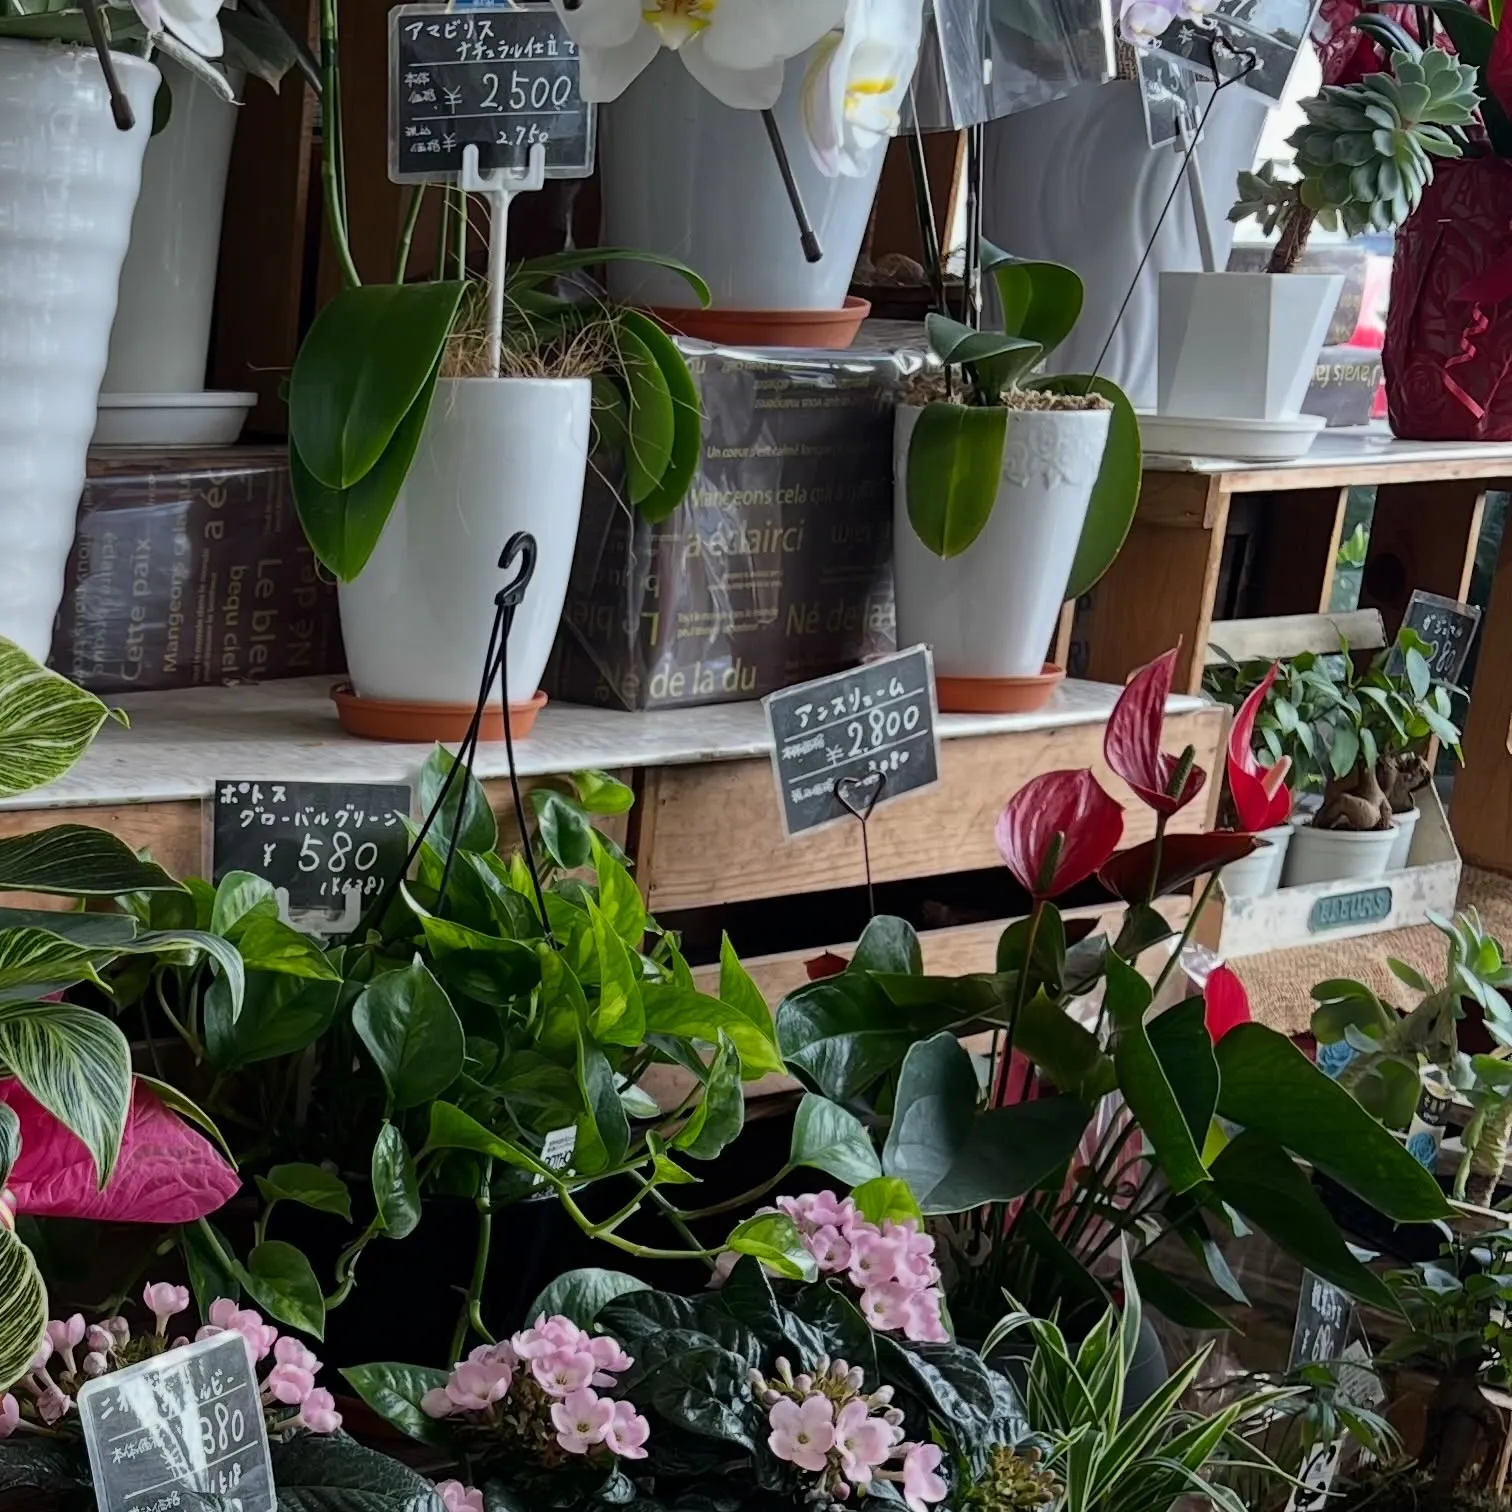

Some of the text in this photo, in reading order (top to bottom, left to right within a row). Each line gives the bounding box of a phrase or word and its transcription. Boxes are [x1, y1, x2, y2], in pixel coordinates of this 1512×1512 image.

[254, 559, 283, 599] Le
[120, 606, 147, 682] Cette
[649, 658, 756, 699] de la du
[221, 782, 287, 804] ポトス
[240, 804, 397, 828] グローバルグリーン
